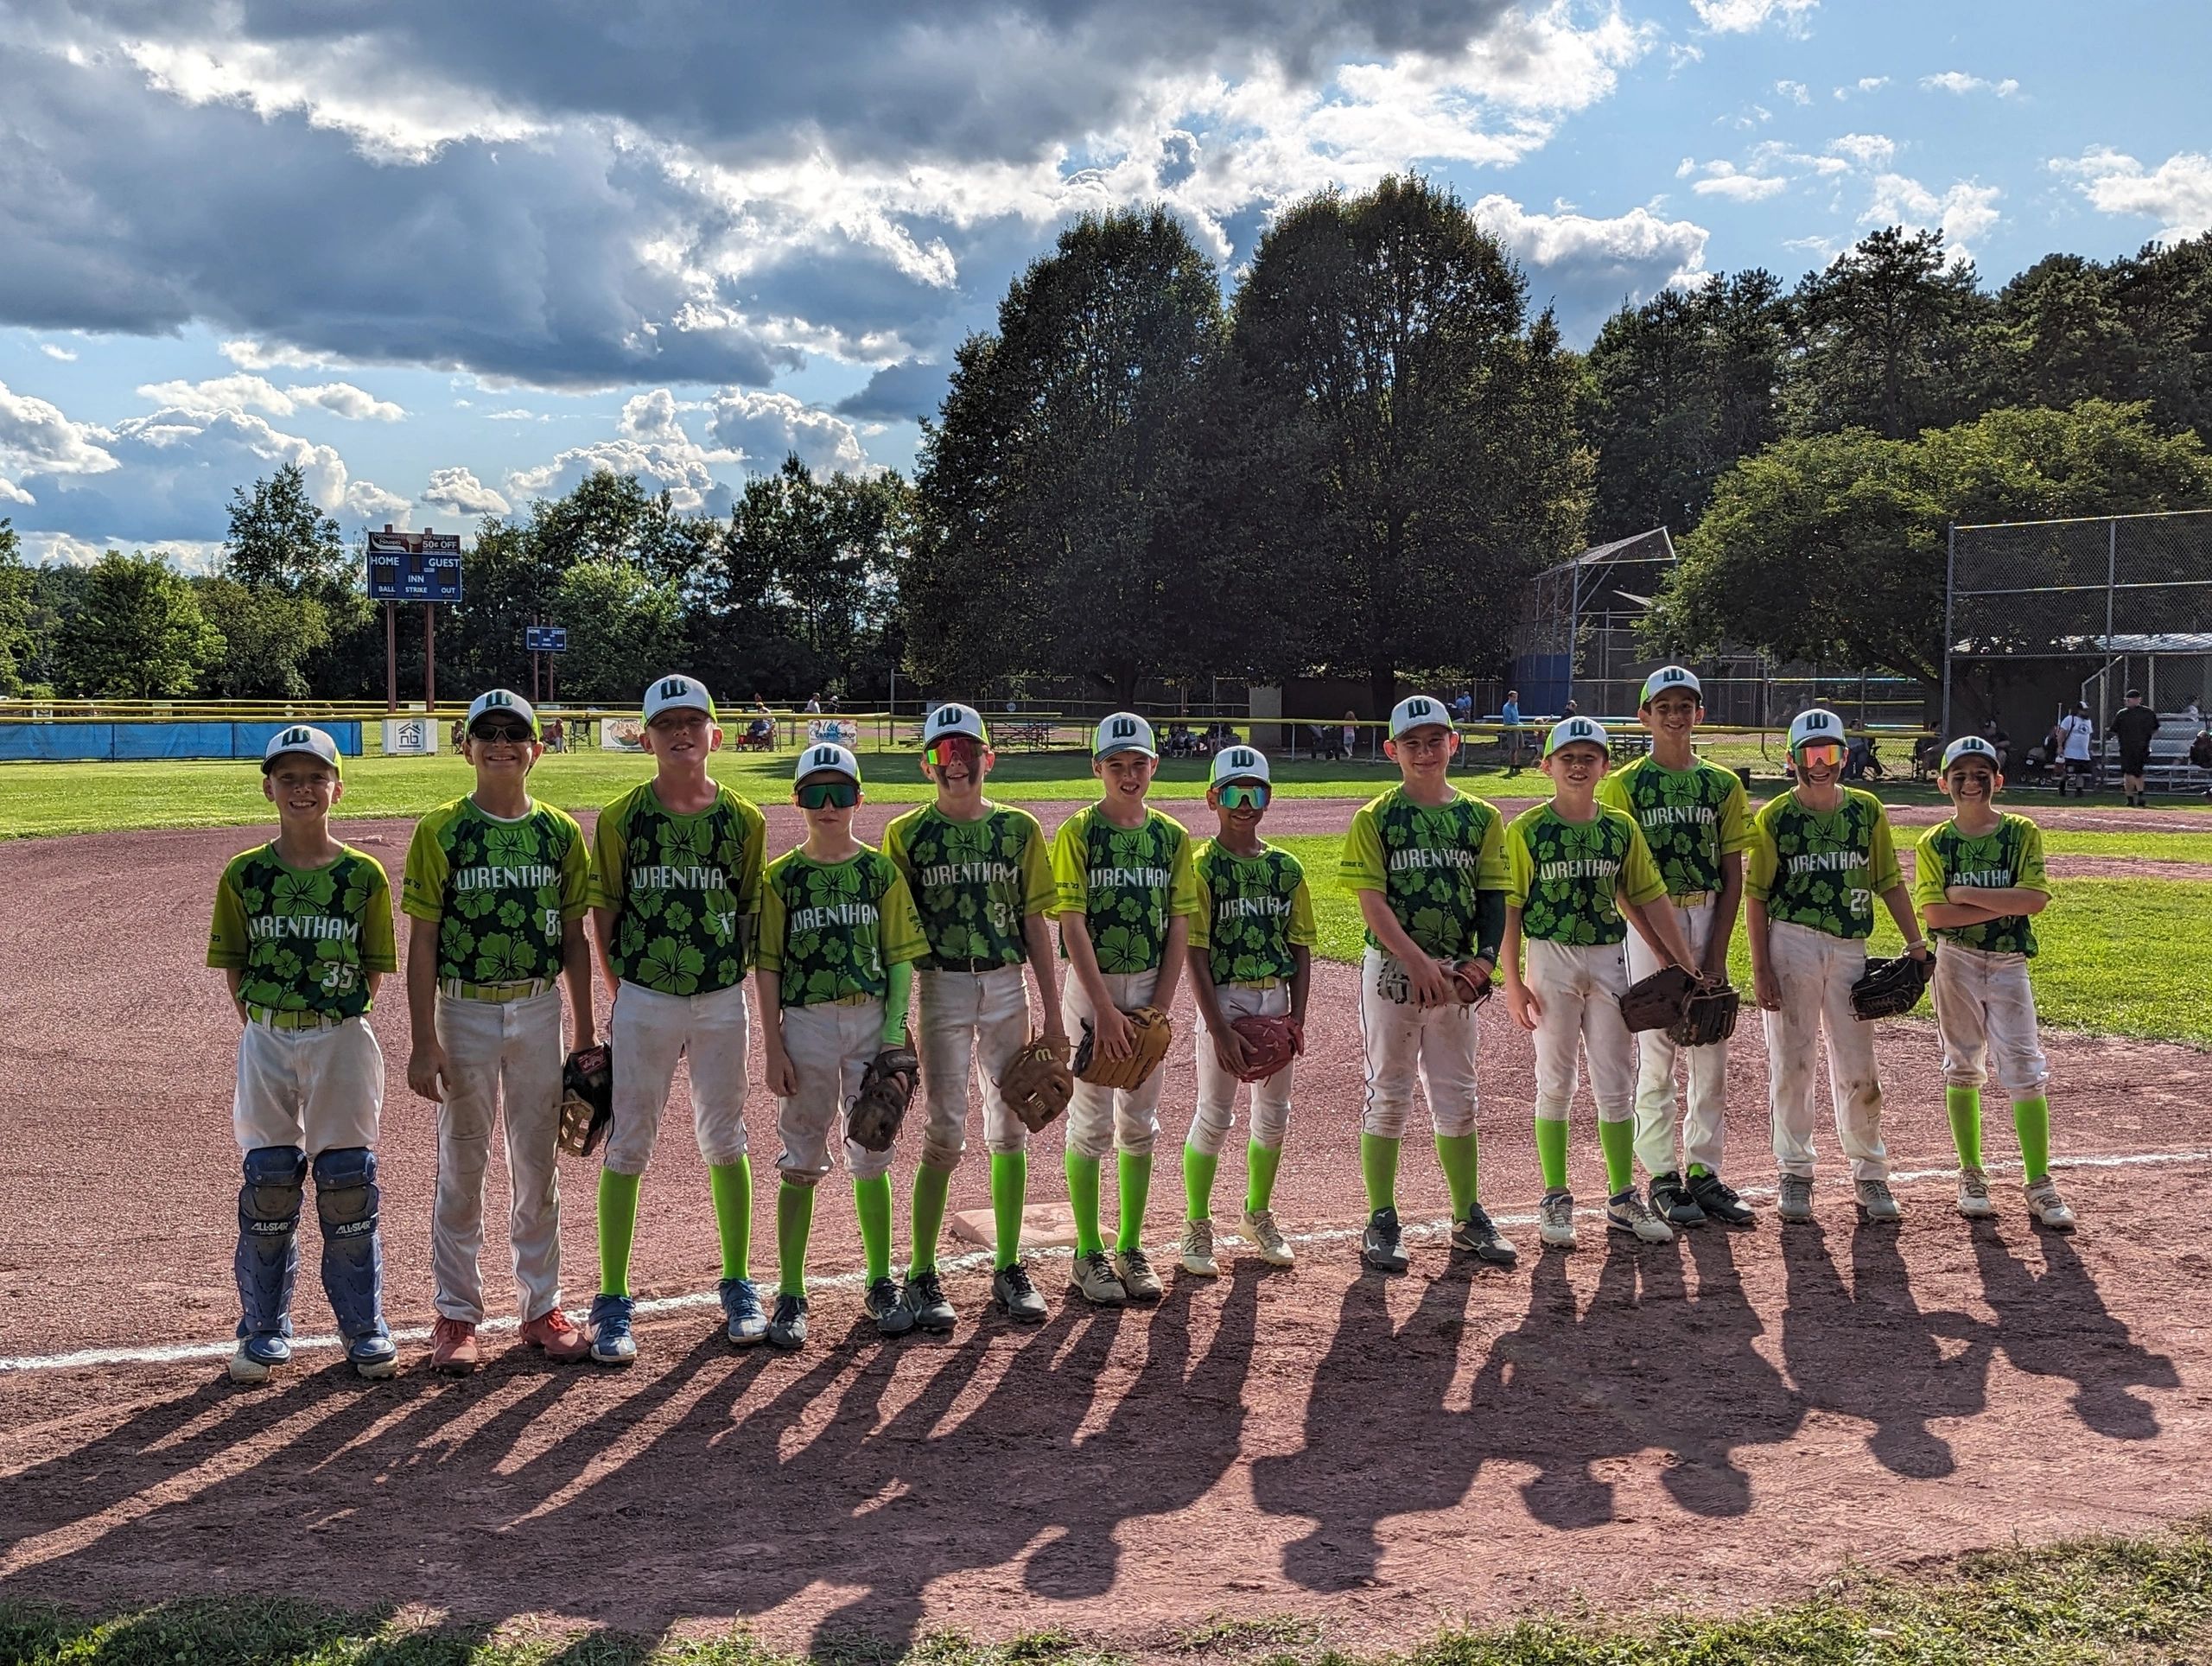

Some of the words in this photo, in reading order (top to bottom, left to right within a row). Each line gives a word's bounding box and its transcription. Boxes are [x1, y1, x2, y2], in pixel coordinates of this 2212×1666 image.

[371, 556, 399, 566] HOME
[429, 558, 460, 568] GUEST
[408, 575, 424, 583] INN
[922, 862, 1019, 887] WRENTHAM
[1540, 858, 1621, 881] WRENTHAM
[1949, 869, 2011, 887] RENTHA
[1158, 907, 1168, 933] 1
[322, 961, 359, 989] 35
